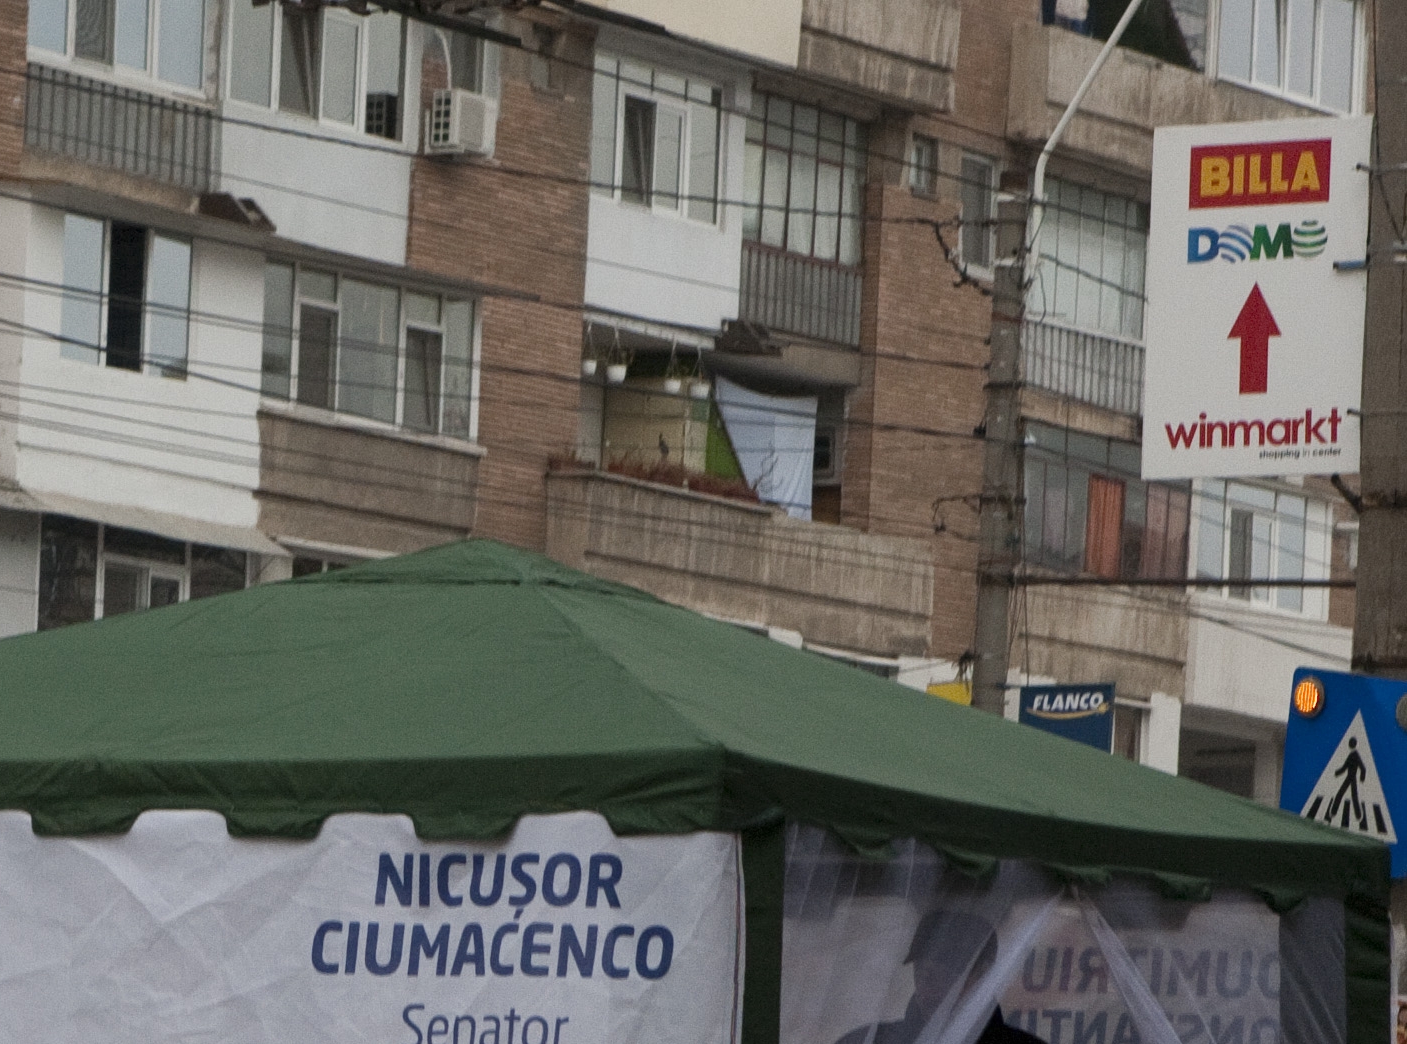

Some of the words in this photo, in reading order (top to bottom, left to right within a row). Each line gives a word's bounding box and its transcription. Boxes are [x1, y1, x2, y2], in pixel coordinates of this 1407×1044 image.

[1199, 150, 1321, 198] BILLA
[1186, 219, 1329, 265] DOMO
[1164, 406, 1342, 451] winmarkt
[1033, 691, 1105, 712] FLANCO
